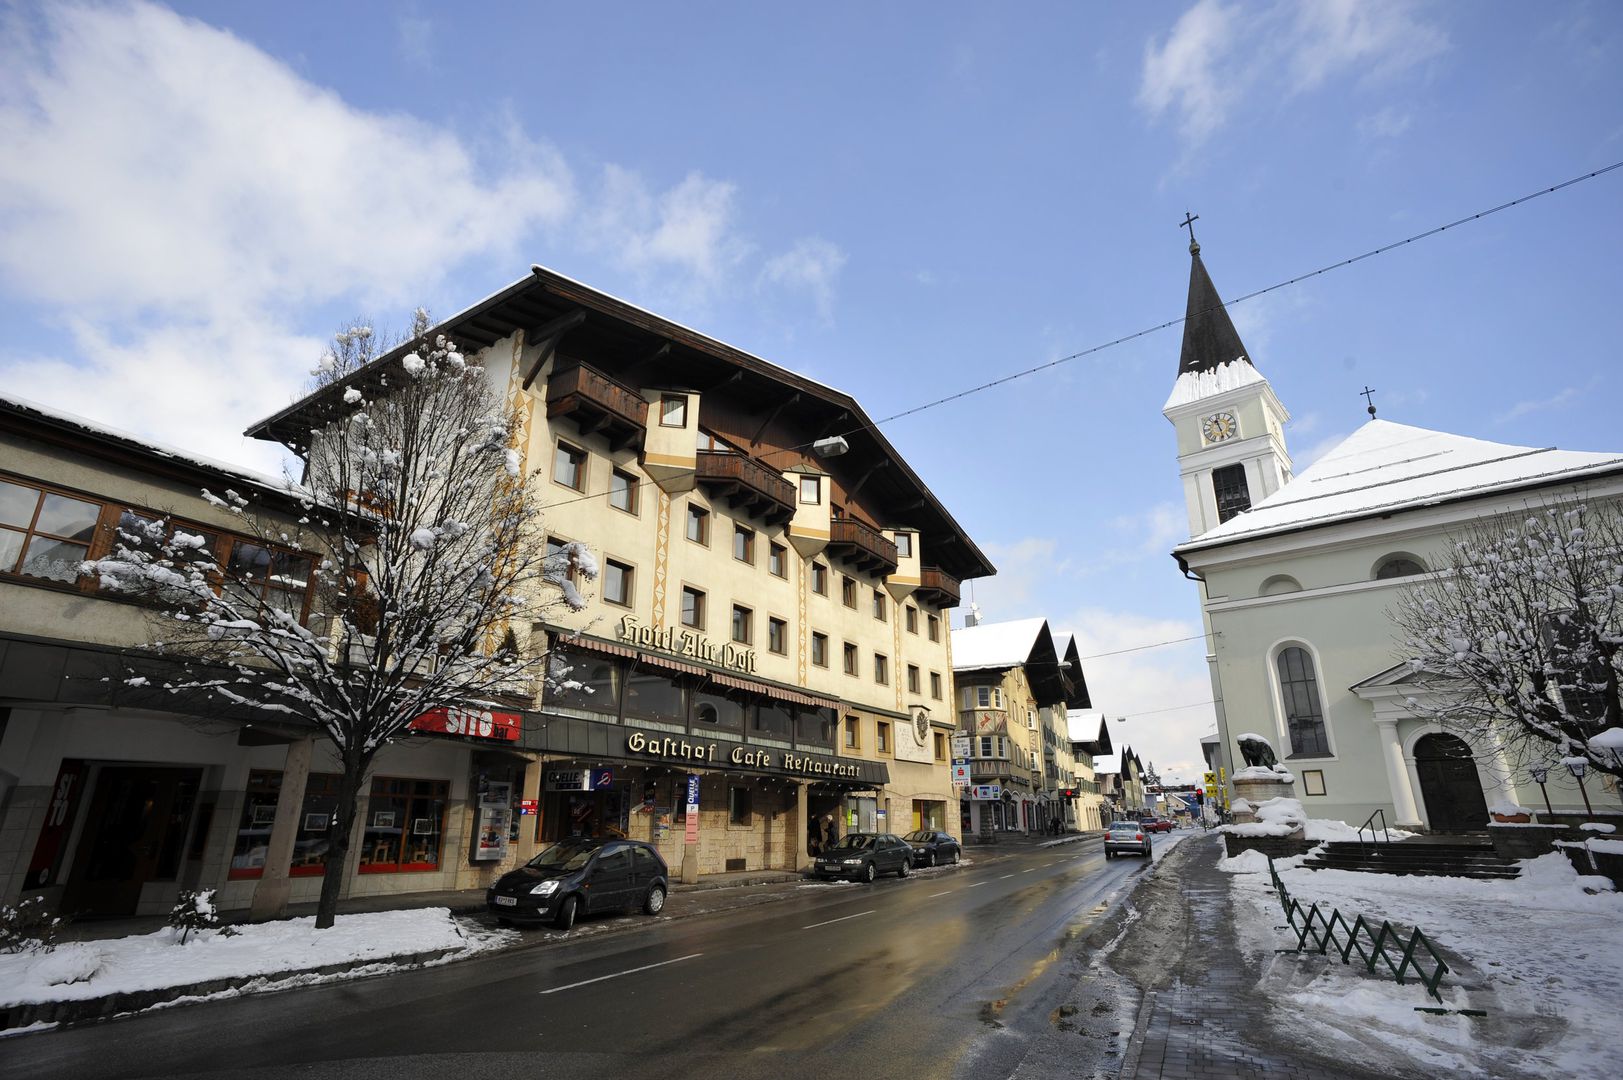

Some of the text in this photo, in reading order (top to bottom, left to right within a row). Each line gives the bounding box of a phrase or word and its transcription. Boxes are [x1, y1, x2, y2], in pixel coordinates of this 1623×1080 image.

[621, 614, 759, 673] Hotel Alte Post
[446, 706, 509, 739] SITO bar
[628, 732, 861, 777] Gasthof Cafe Restaurant
